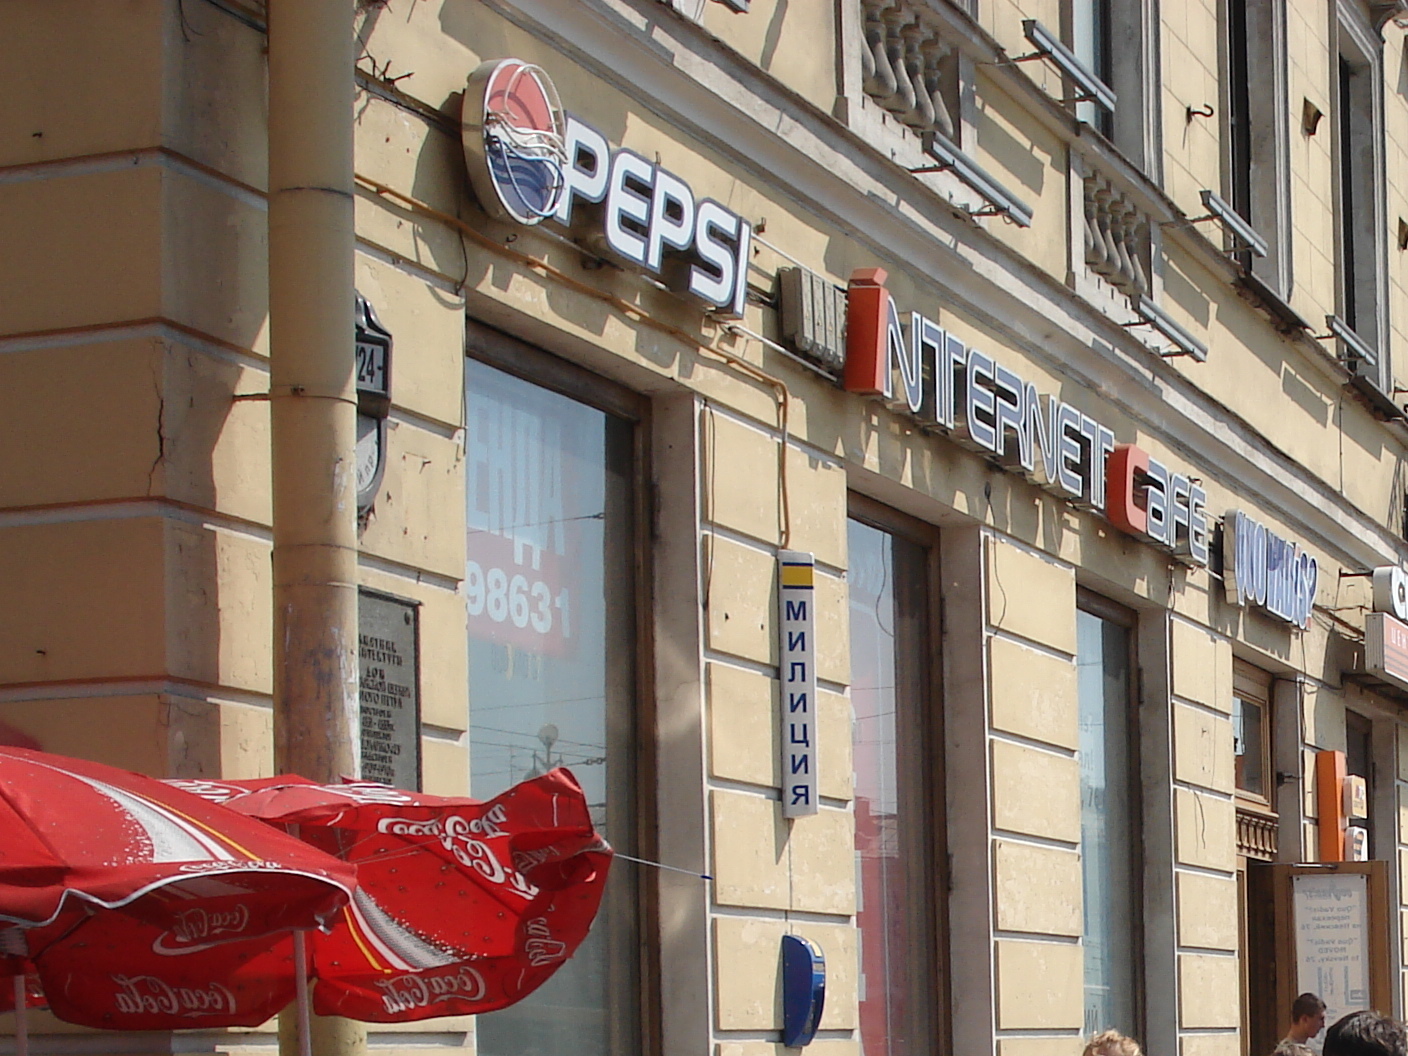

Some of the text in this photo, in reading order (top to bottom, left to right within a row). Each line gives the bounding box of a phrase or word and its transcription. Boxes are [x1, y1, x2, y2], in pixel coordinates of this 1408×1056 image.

[556, 111, 752, 318] PEPSI
[466, 559, 571, 639] 98631
[785, 600, 811, 806] МИЛИЦИЯ
